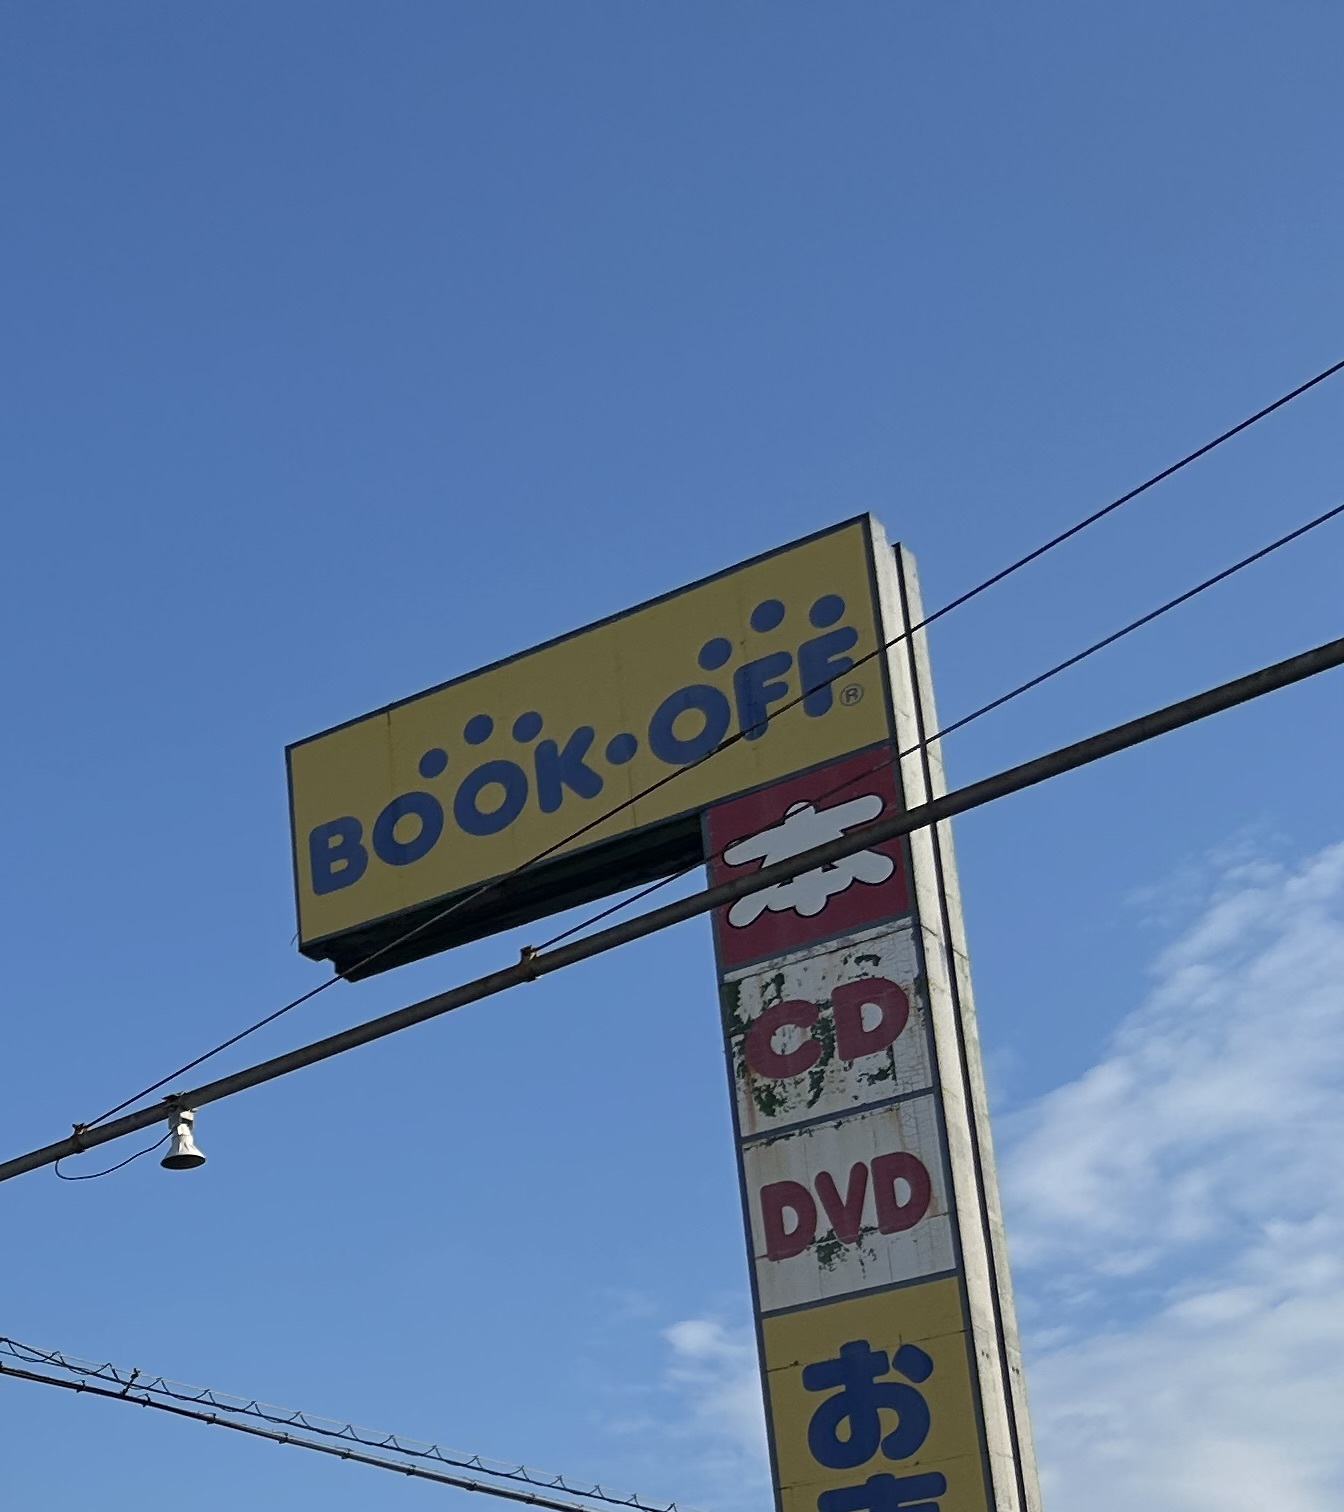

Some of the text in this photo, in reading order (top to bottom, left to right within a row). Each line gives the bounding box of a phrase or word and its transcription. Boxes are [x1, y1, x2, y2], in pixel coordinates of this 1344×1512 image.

[723, 801, 896, 929] 本
[745, 978, 910, 1079] CD
[759, 1152, 932, 1262] DVD
